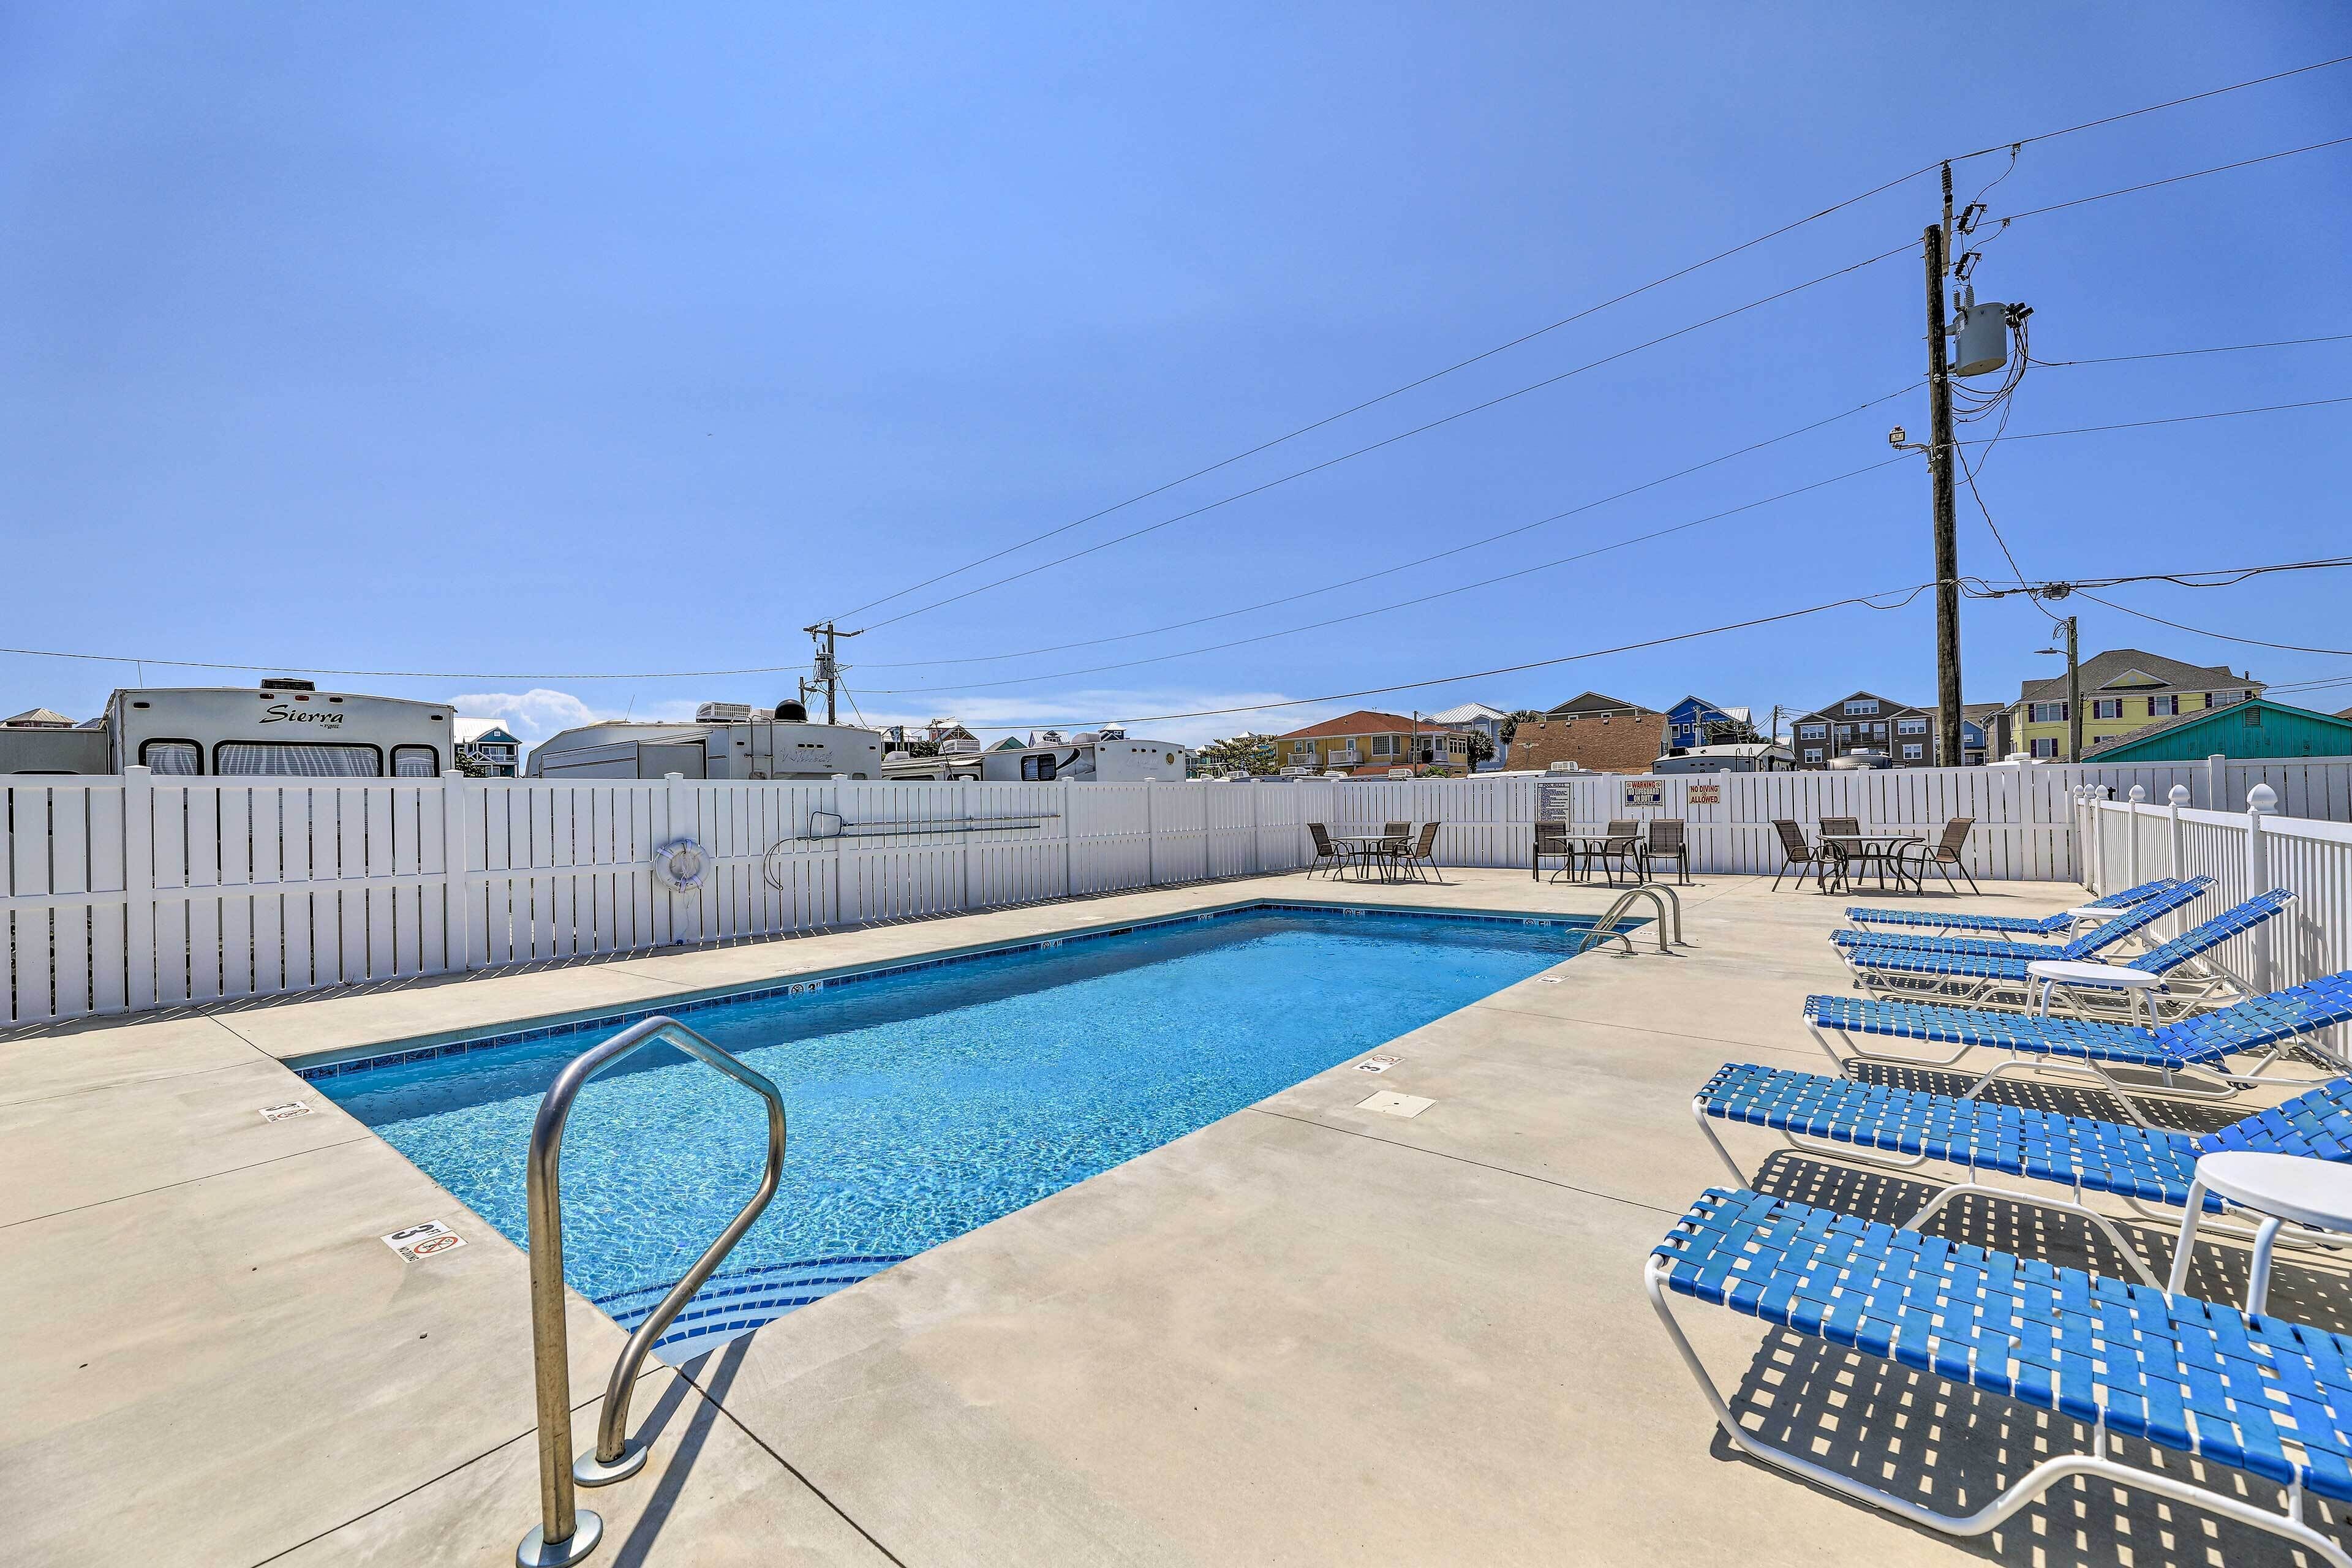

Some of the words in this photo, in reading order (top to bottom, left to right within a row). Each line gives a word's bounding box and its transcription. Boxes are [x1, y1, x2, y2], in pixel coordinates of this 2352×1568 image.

[258, 704, 344, 723] Sierra
[391, 1224, 434, 1240] 3
[401, 1250, 420, 1262] DIVING
